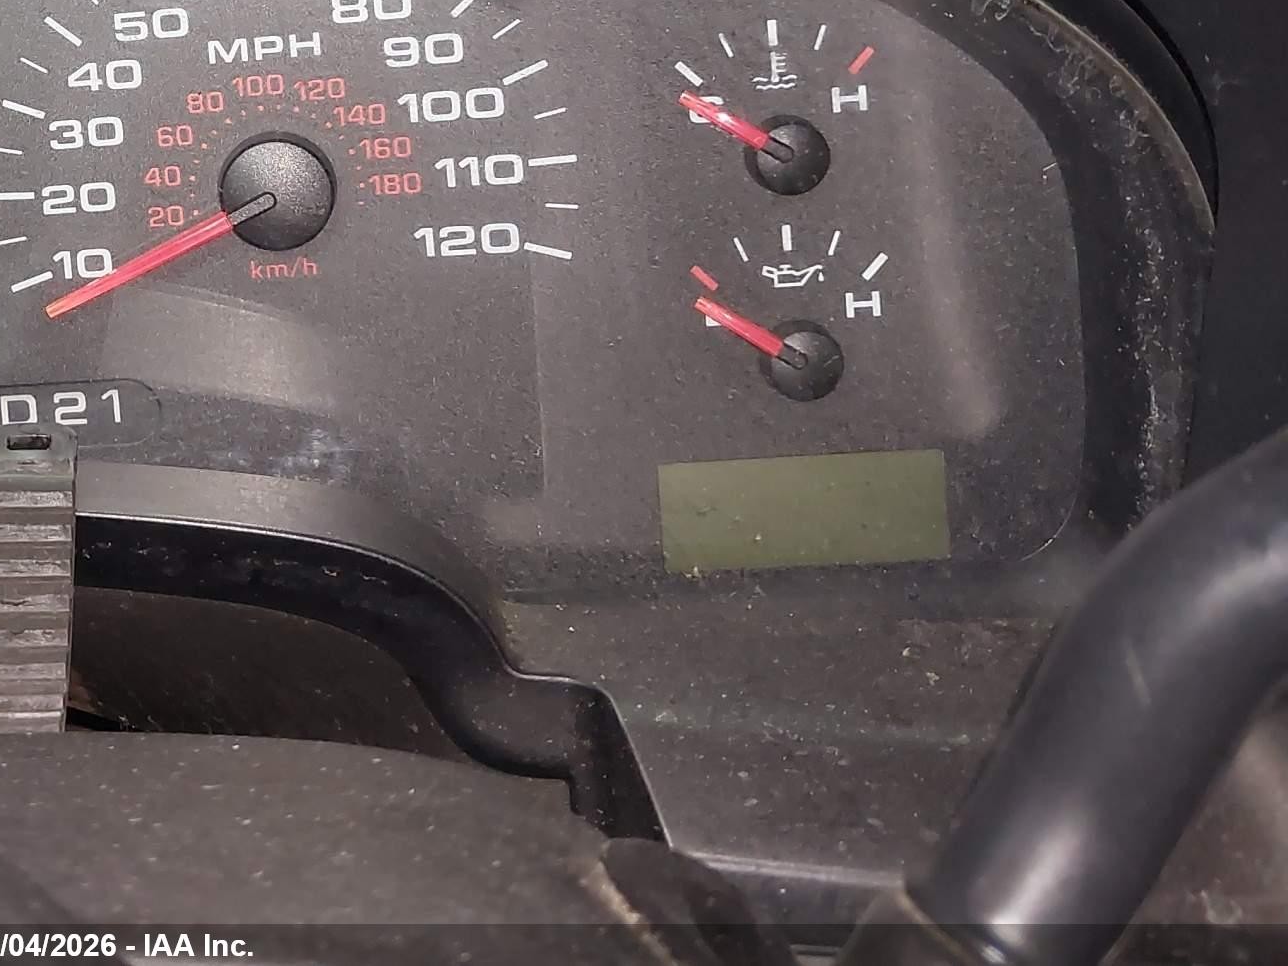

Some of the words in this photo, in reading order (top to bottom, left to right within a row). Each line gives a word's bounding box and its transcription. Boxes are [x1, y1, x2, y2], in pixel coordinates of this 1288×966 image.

[114, 8, 189, 41] 50
[208, 32, 321, 64] MPH
[384, 33, 463, 67] 90
[68, 60, 142, 91] 40
[234, 74, 284, 97] 100
[188, 93, 223, 113] 80
[296, 78, 344, 101] 120
[832, 85, 867, 113] H
[335, 104, 385, 124] 140
[398, 88, 504, 122] 100
[49, 117, 123, 149] 30
[157, 125, 193, 146] 60
[362, 138, 410, 158] 160
[146, 166, 180, 186] 40
[371, 172, 421, 195] 180
[435, 154, 523, 187] 110
[42, 182, 115, 214] 20
[149, 205, 185, 228] 20
[414, 223, 519, 256] 120
[52, 249, 113, 278] 10
[249, 259, 317, 279] km/h
[846, 291, 881, 318] H
